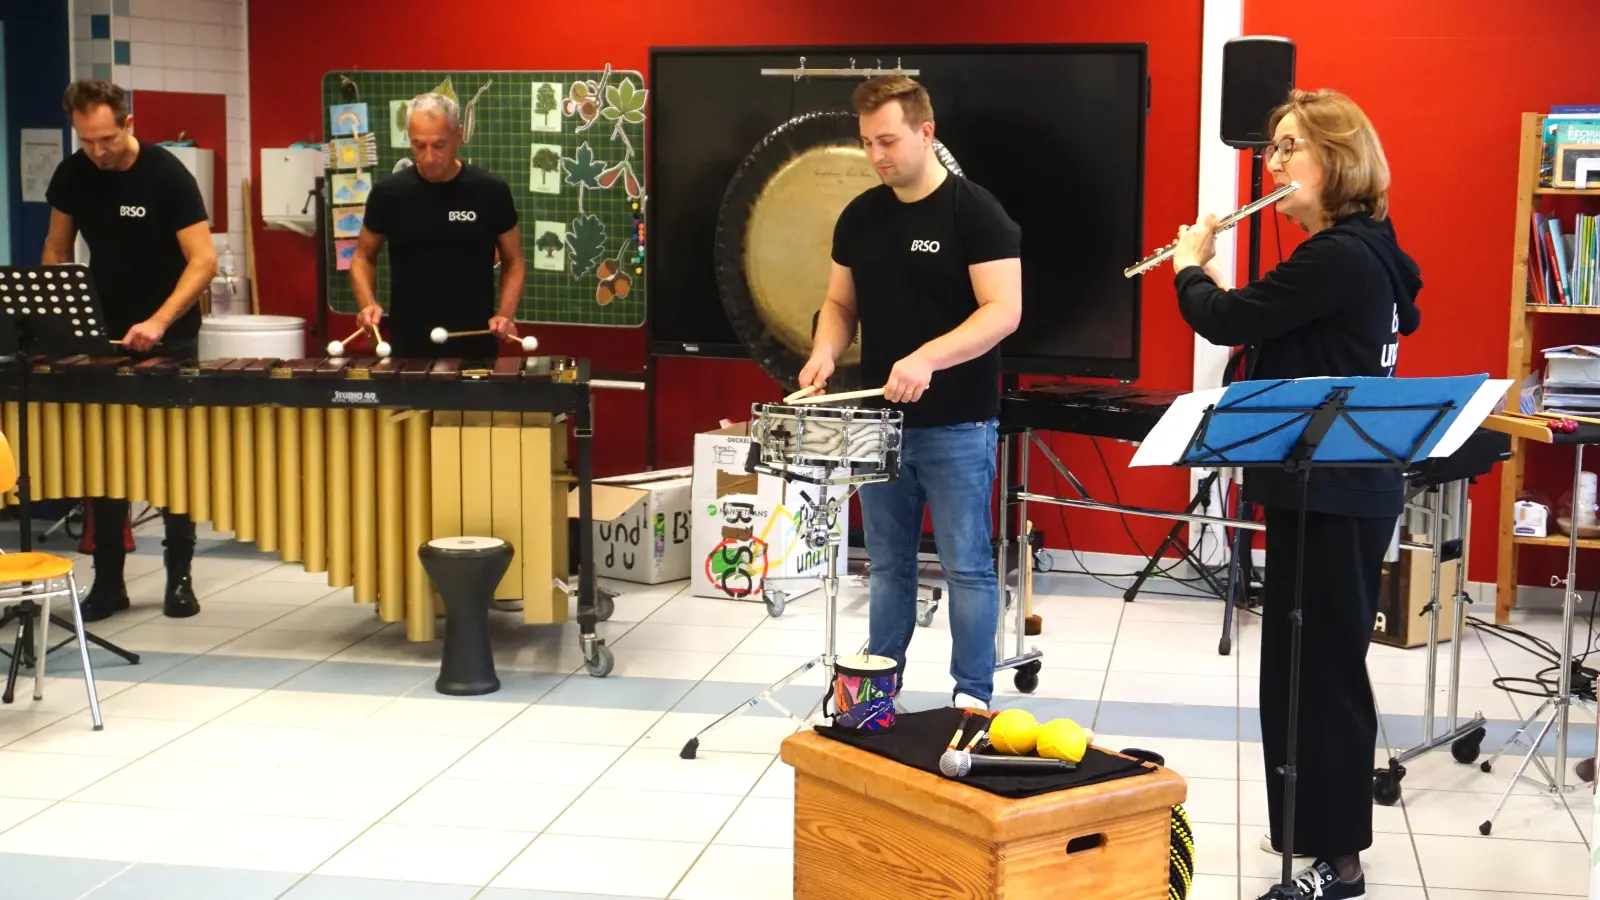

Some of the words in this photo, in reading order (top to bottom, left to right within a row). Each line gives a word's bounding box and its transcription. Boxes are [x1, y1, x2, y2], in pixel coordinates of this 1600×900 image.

[120, 205, 146, 217] BRSO
[448, 211, 477, 221] BRSO
[911, 240, 940, 253] BRSO
[599, 514, 641, 546] und
[672, 510, 691, 544] B
[721, 501, 754, 598] BSO
